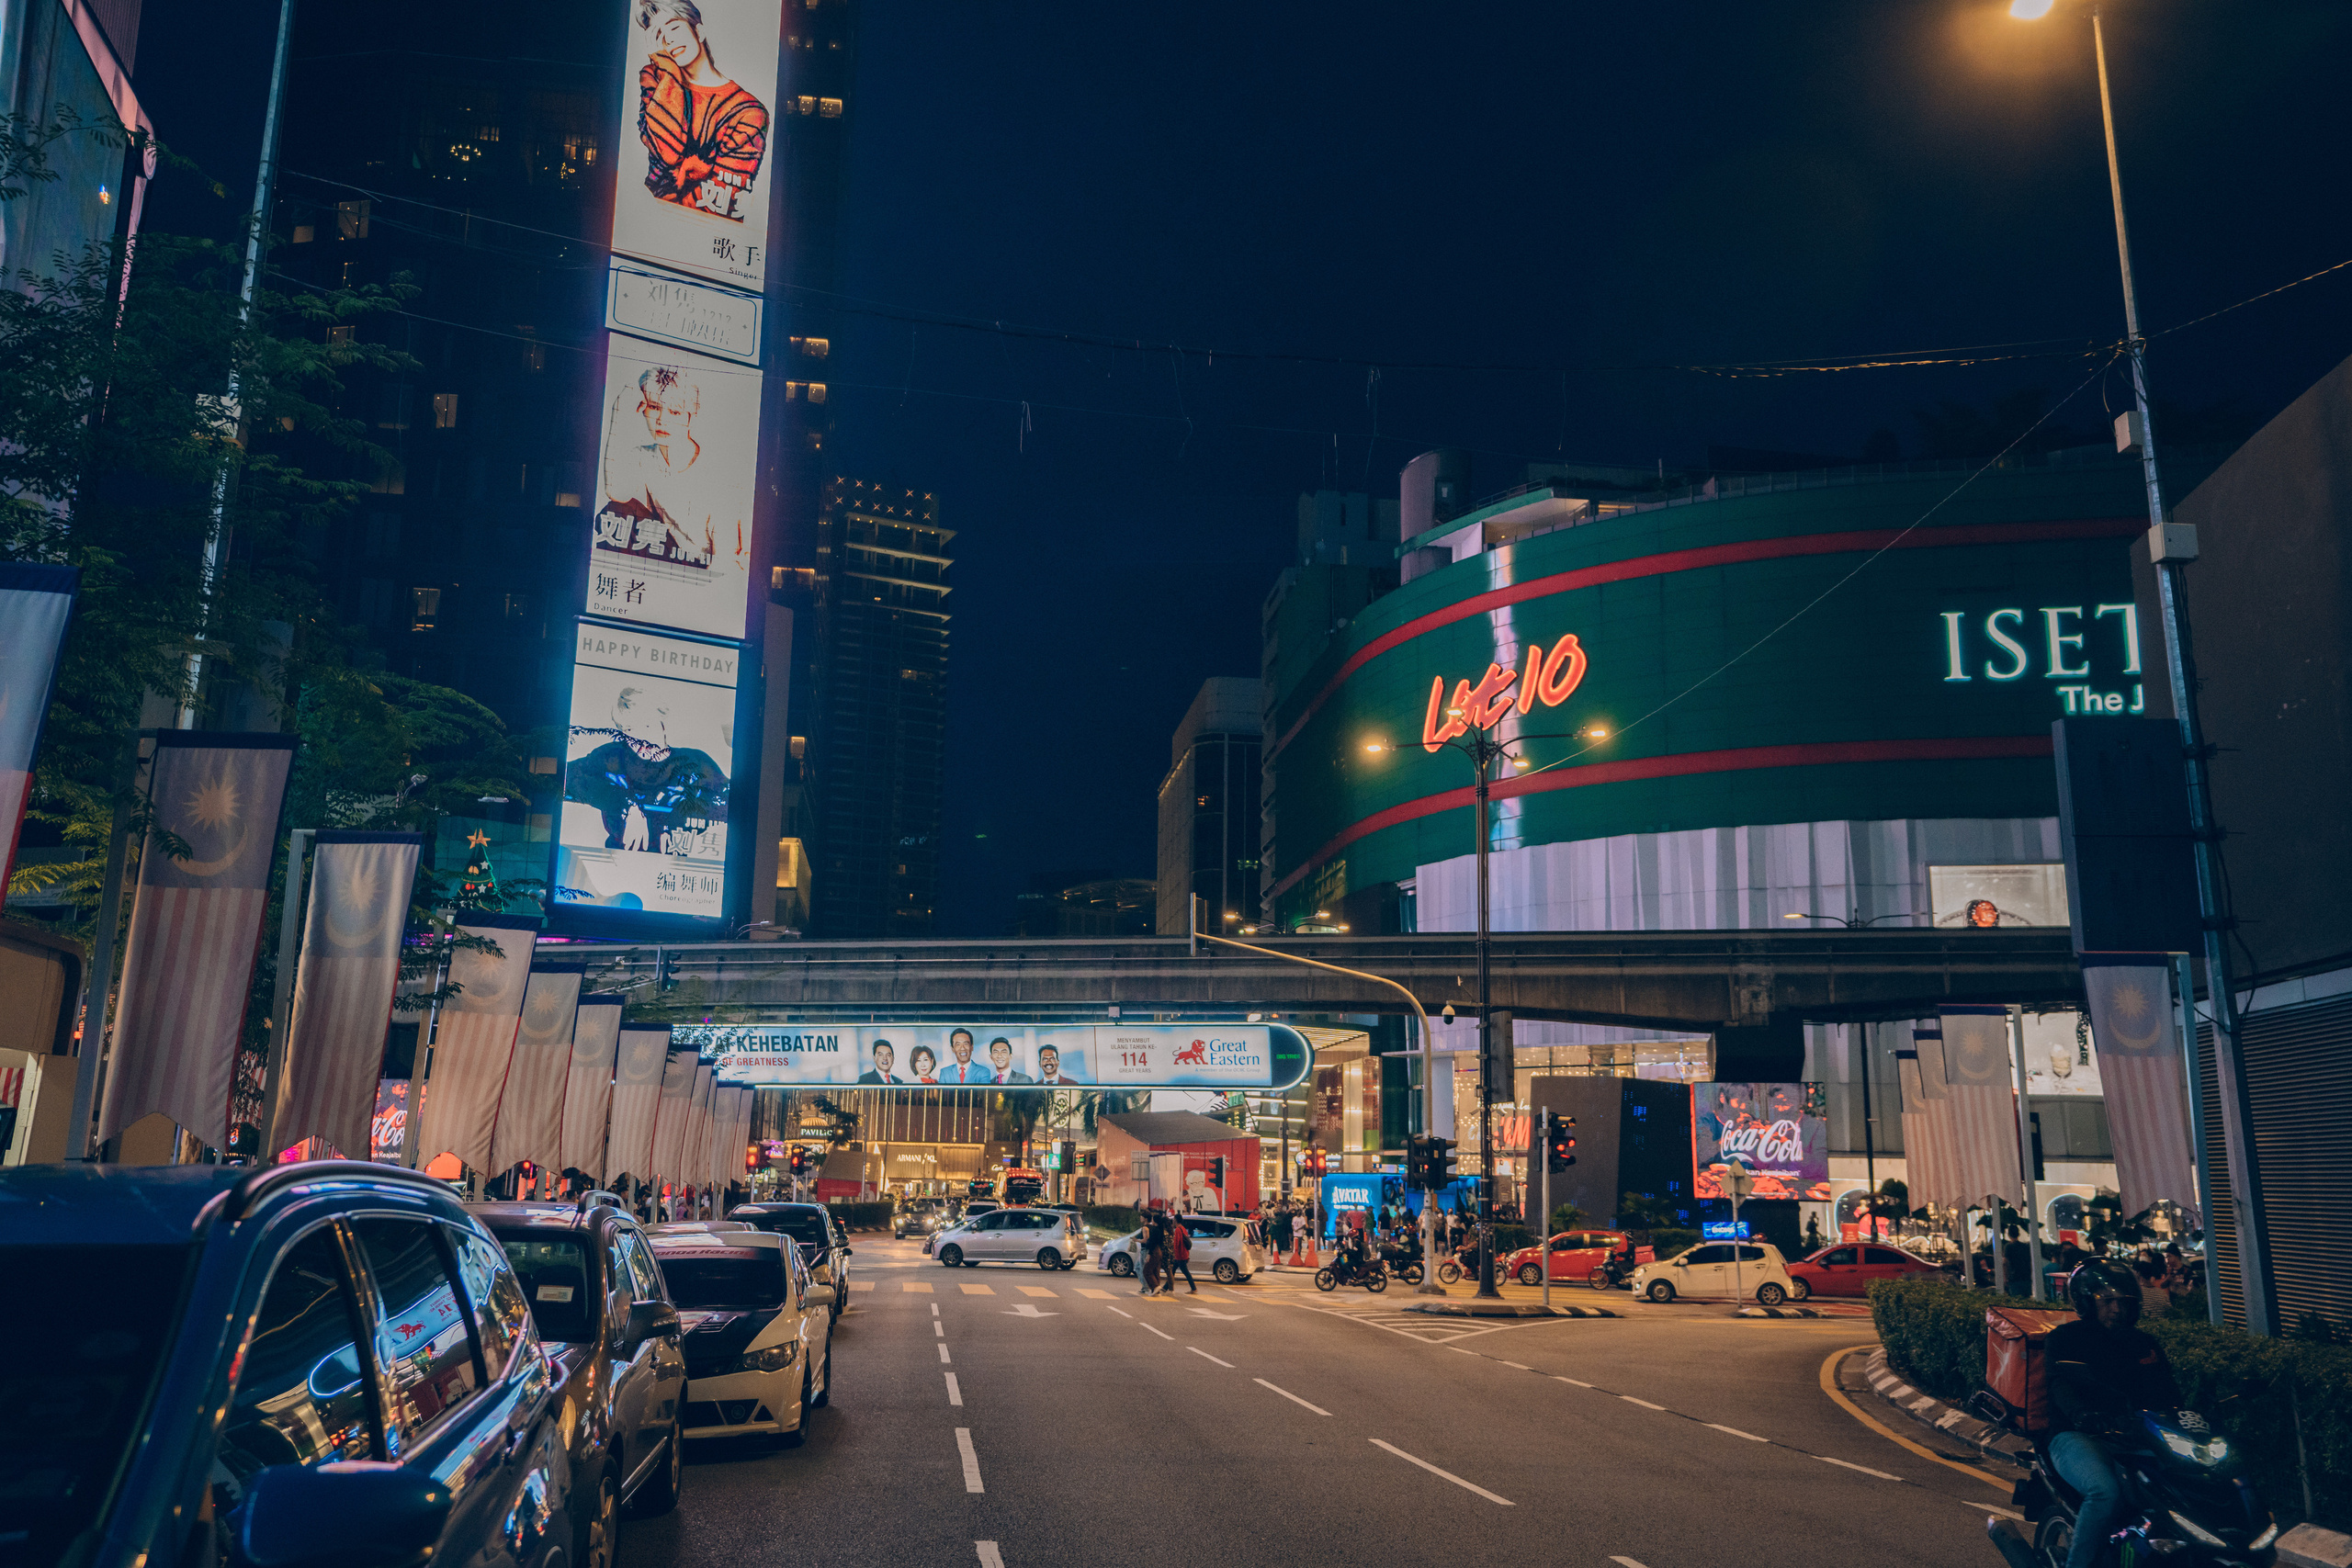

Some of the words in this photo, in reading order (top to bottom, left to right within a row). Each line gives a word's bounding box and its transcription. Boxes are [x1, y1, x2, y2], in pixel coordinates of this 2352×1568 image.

[717, 170, 741, 186] JUN
[713, 236, 761, 266] 歌手
[729, 266, 757, 279] Singer
[595, 573, 646, 604] 舞者
[594, 603, 628, 615] Dancer
[582, 637, 641, 659] HAPPY
[650, 649, 733, 673] BIRTHDAY
[1517, 633, 1588, 715] 10
[2057, 684, 2123, 715] The
[684, 817, 706, 829] JUN
[737, 1035, 839, 1053] KEHEBATAN
[1209, 1038, 1247, 1052] Great
[737, 1057, 789, 1066] GREATNESS
[1121, 1052, 1148, 1066] 114
[1210, 1053, 1261, 1066] Eastern
[1720, 1119, 1804, 1163] Coca-Cola
[897, 1154, 922, 1162] ARMANI
[1331, 1186, 1370, 1204] AVATAR
